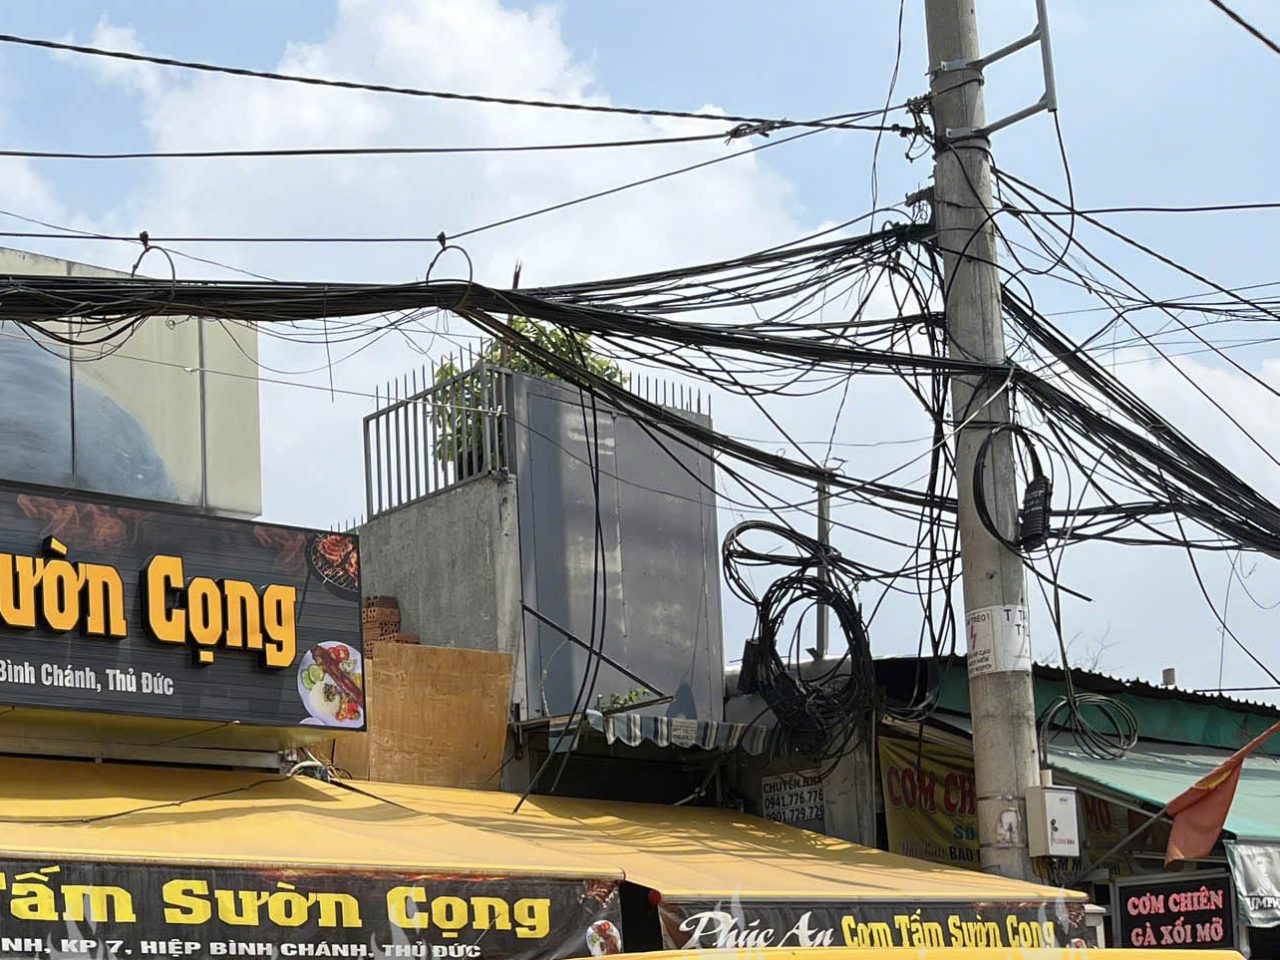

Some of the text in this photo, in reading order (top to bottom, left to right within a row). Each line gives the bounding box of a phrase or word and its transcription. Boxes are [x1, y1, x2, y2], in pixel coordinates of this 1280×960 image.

[145, 553, 297, 668] Cọng
[41, 663, 101, 692] Chánh,
[106, 667, 137, 693] Thủ
[141, 669, 175, 696] Đức
[163, 878, 362, 929] Sườn
[386, 885, 551, 939] Cọng
[1127, 885, 1223, 915] CƠM CHIÊN
[841, 914, 892, 948] Cơm
[894, 908, 943, 948] Tấm
[1131, 916, 1223, 947] GÀ XỐI MỠ
[61, 938, 97, 954] KP
[141, 938, 201, 958] HIỆP
[210, 938, 273, 957] BÌNH
[280, 938, 375, 959] CHÁNH,
[381, 939, 427, 958] THỦ
[431, 940, 481, 959] ĐỨC
